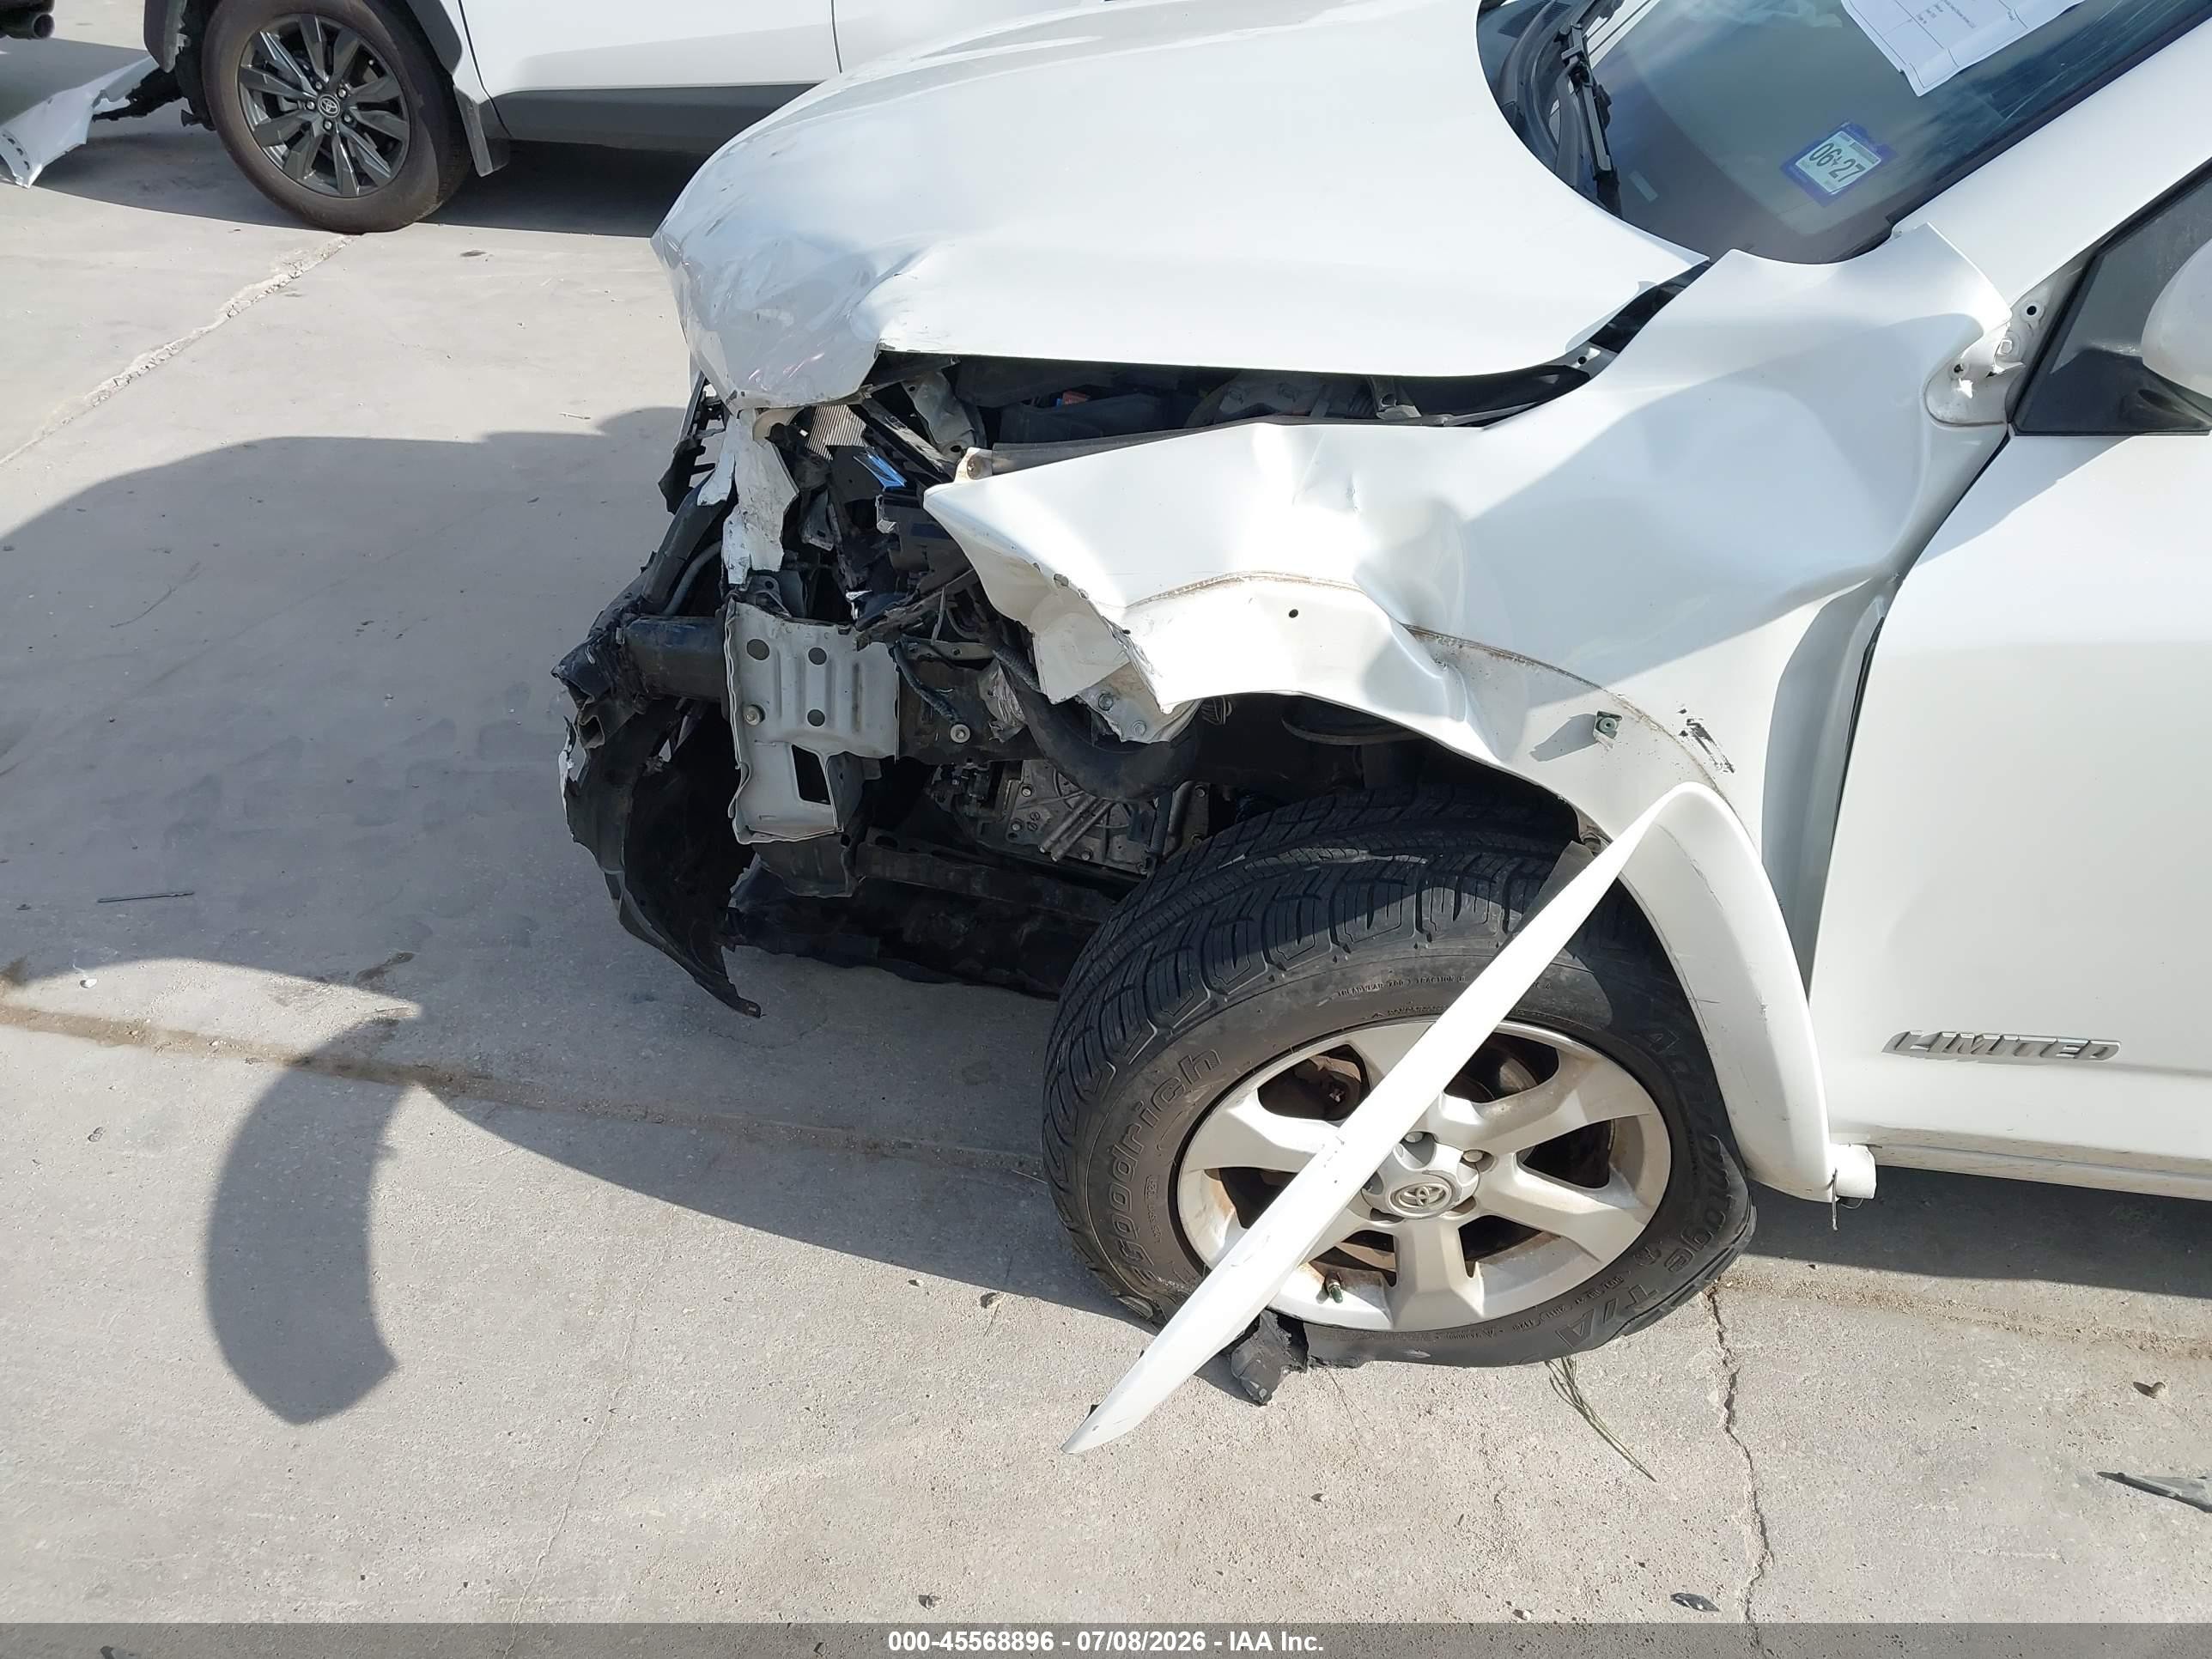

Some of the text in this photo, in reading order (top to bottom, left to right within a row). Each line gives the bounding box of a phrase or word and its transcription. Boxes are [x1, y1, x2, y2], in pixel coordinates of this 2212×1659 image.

[1808, 142, 1867, 183] 06 27
[1881, 1030, 2123, 1061] LIMITED
